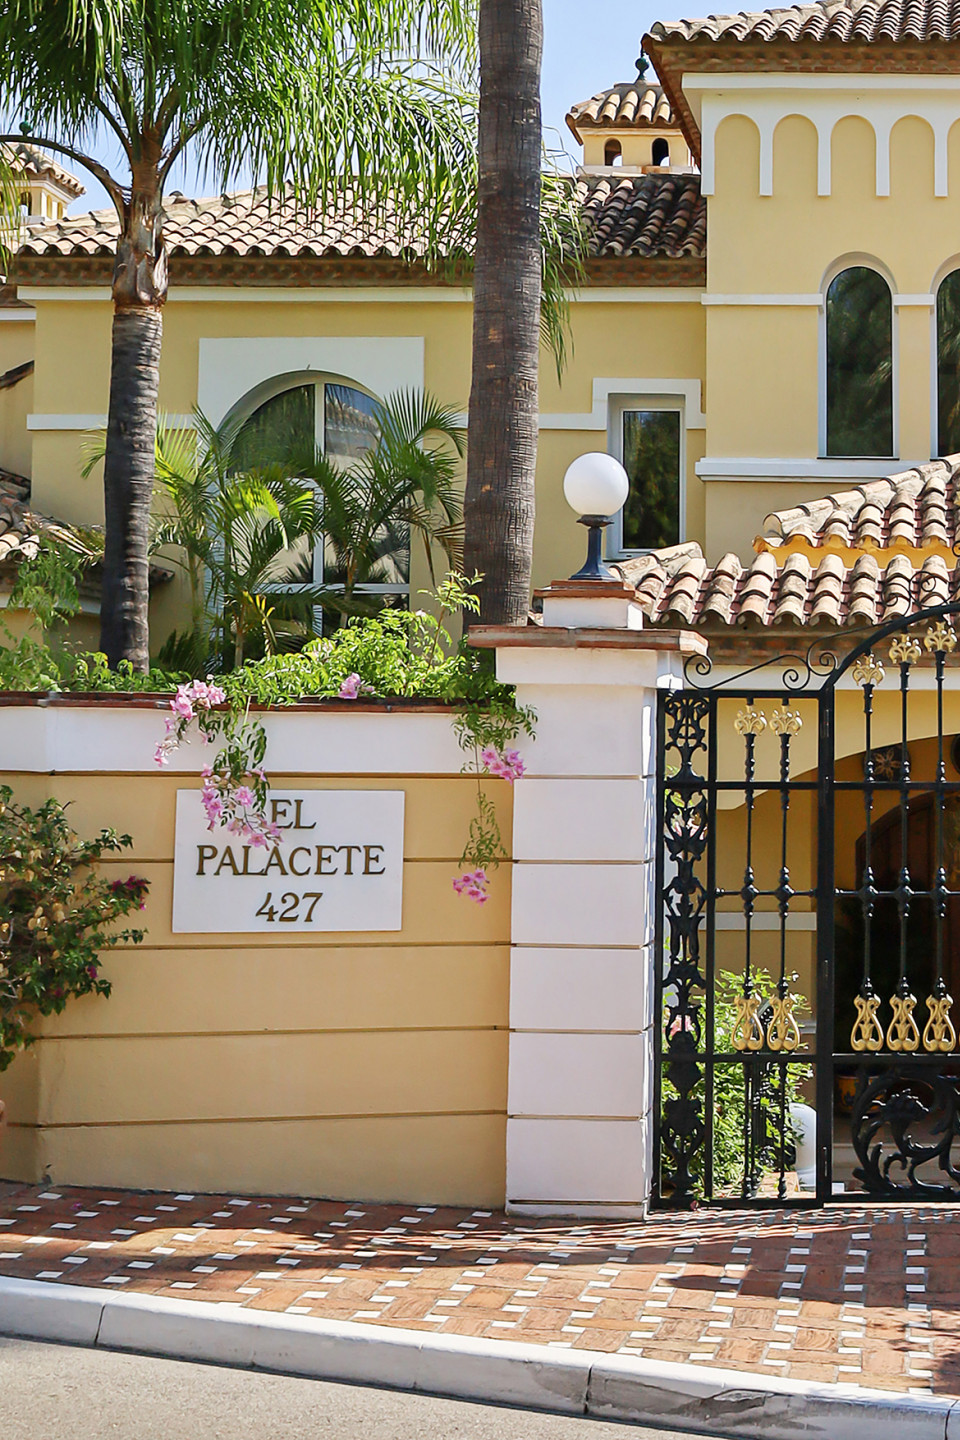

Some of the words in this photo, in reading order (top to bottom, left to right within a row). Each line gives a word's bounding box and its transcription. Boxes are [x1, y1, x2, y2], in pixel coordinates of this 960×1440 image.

[270, 799, 317, 829] EL
[196, 845, 386, 876] PALACETE
[255, 892, 323, 922] 427
